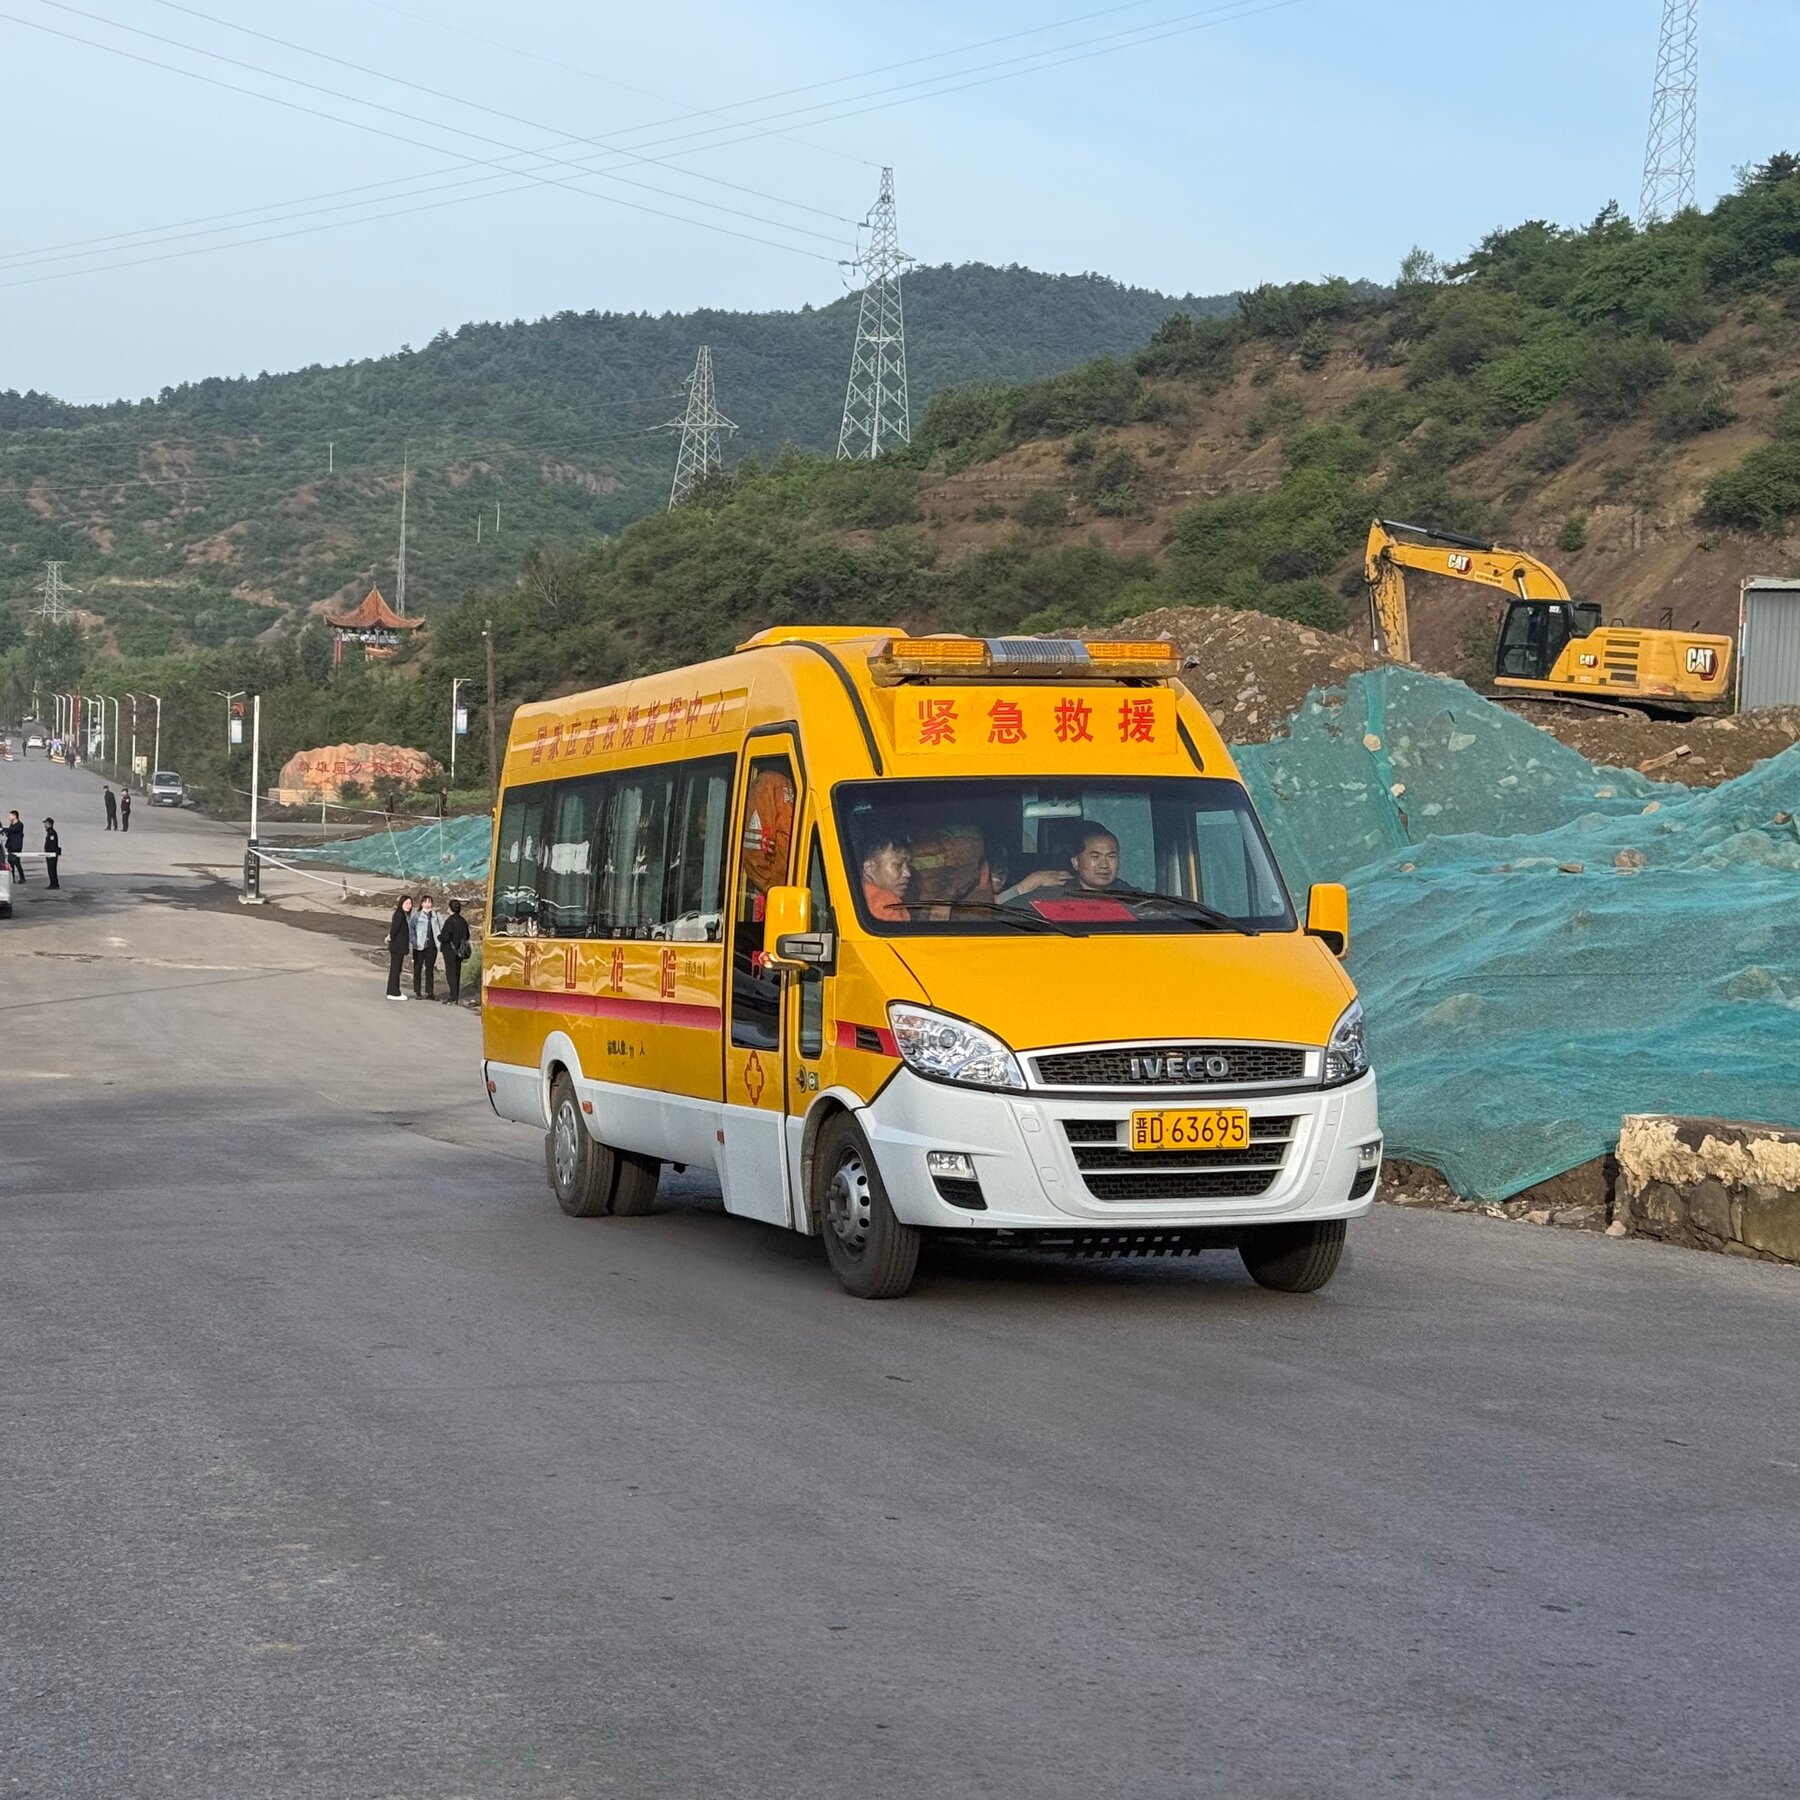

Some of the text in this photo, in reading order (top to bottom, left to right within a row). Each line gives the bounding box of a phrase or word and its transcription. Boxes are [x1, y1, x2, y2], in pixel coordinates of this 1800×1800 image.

[1448, 553, 1469, 571] CAT
[1580, 654, 1595, 666] CAT
[1687, 647, 1713, 673] CAT
[918, 697, 1156, 745] 紧急救援
[1130, 1056, 1229, 1079] IVECO
